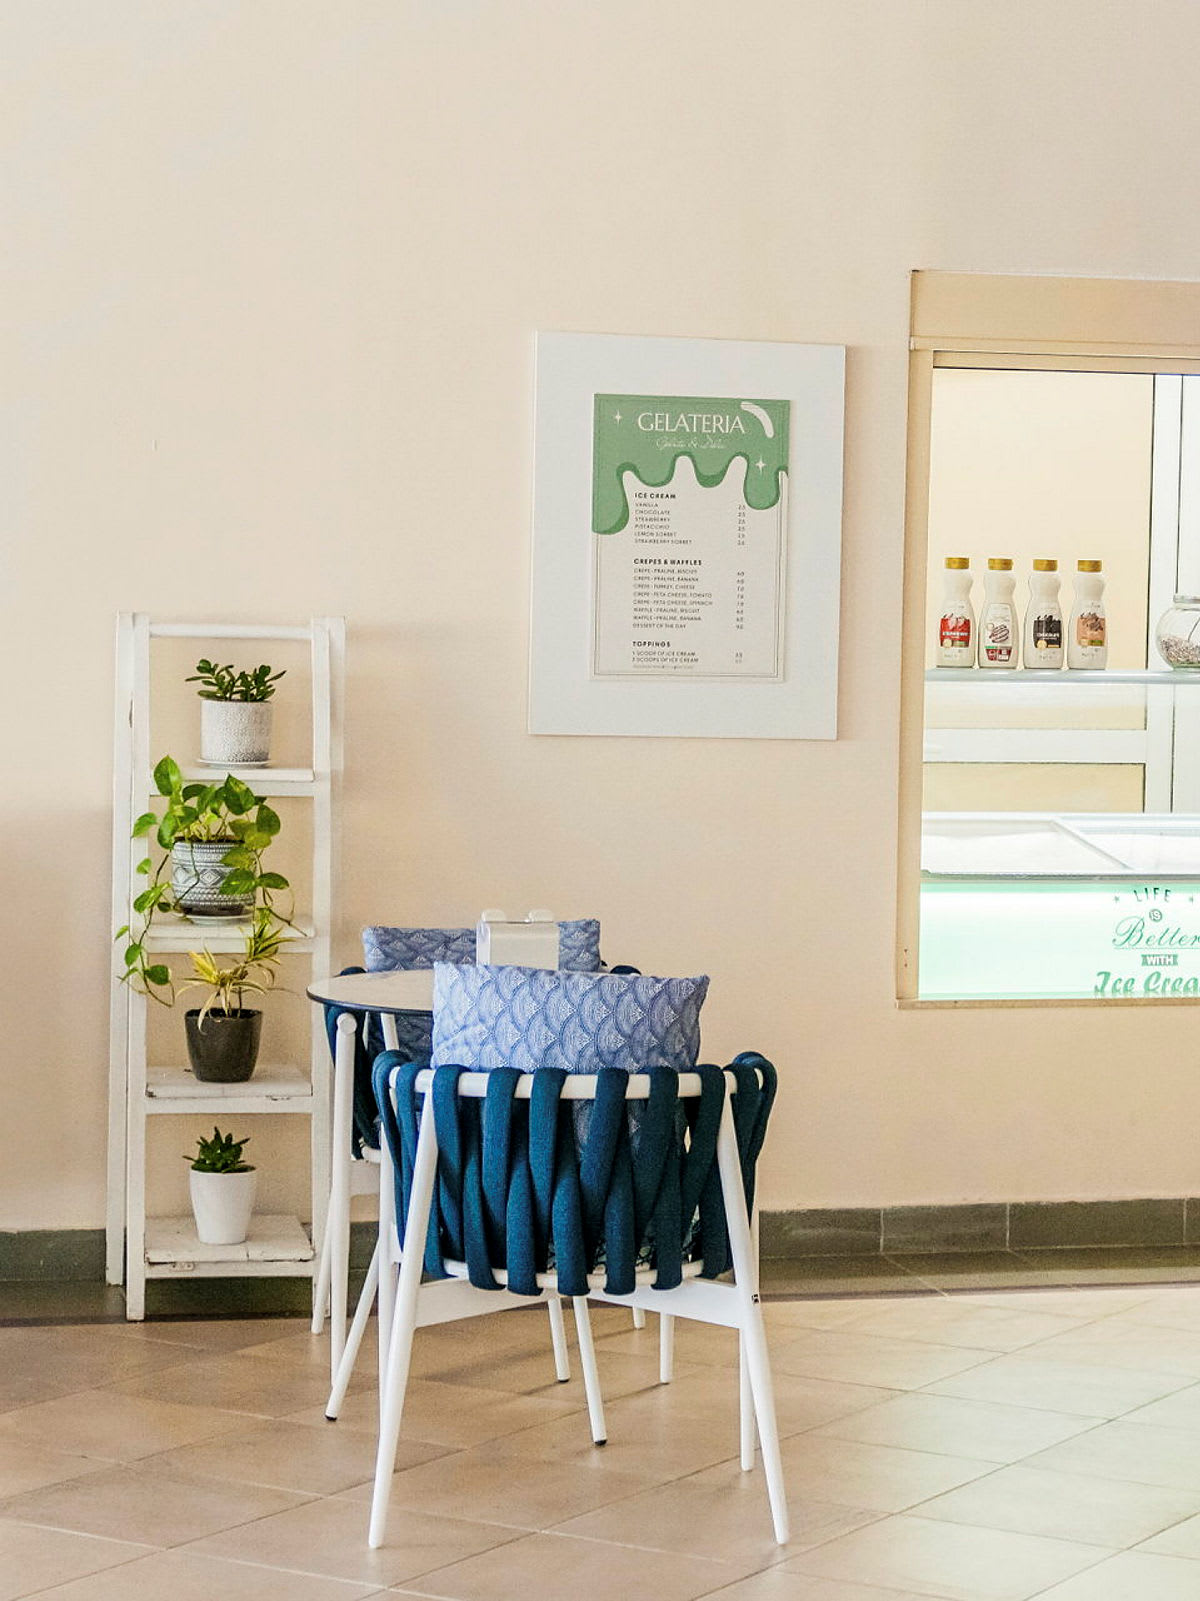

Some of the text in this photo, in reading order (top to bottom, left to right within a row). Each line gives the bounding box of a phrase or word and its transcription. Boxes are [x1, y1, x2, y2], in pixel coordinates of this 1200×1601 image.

[638, 412, 746, 434] GELATERIA
[1133, 887, 1171, 902] LIFE
[1146, 955, 1174, 966] WITH
[1094, 971, 1135, 995] Ice
